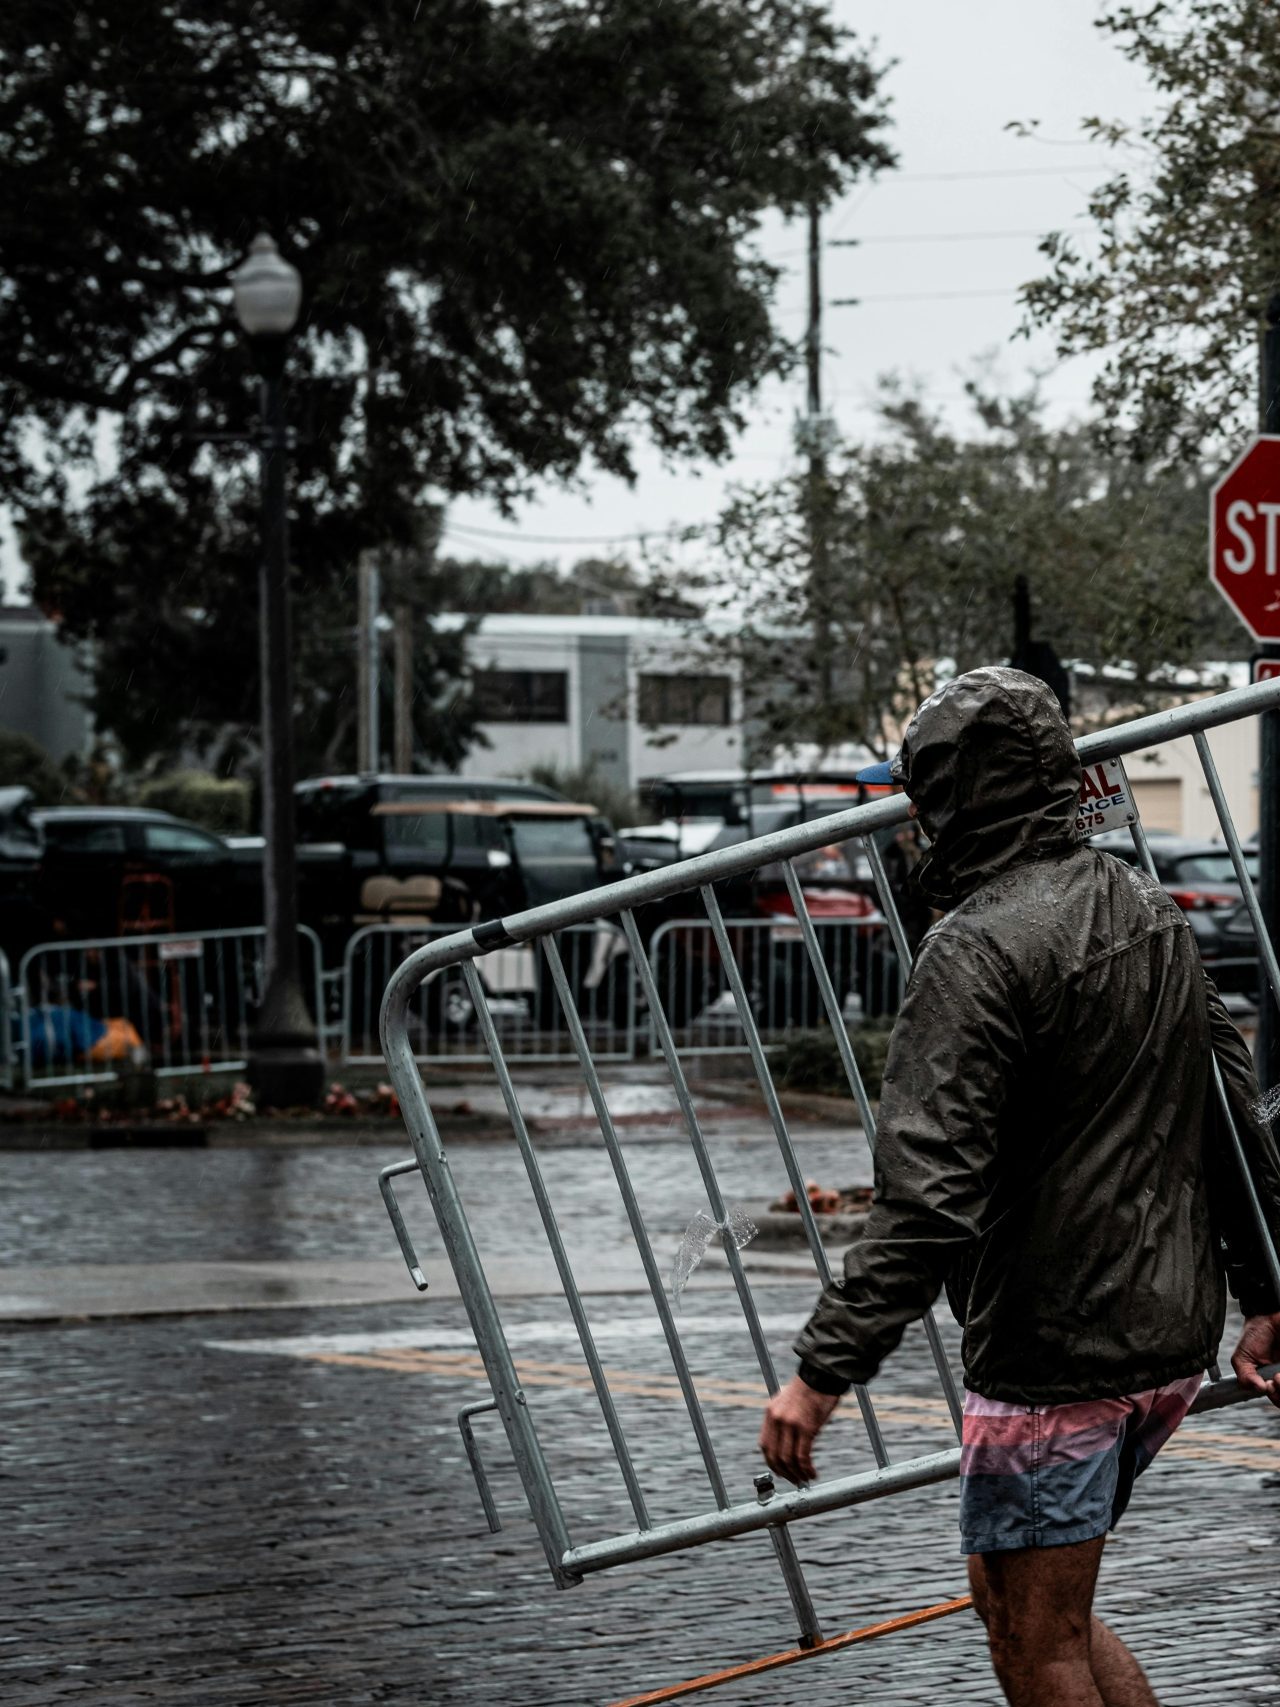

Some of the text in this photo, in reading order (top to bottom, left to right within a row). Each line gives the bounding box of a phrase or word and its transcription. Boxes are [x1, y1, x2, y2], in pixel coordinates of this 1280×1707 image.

[1080, 764, 1121, 804] AL
[1079, 793, 1125, 815] NCE
[1075, 812, 1105, 831] 675
